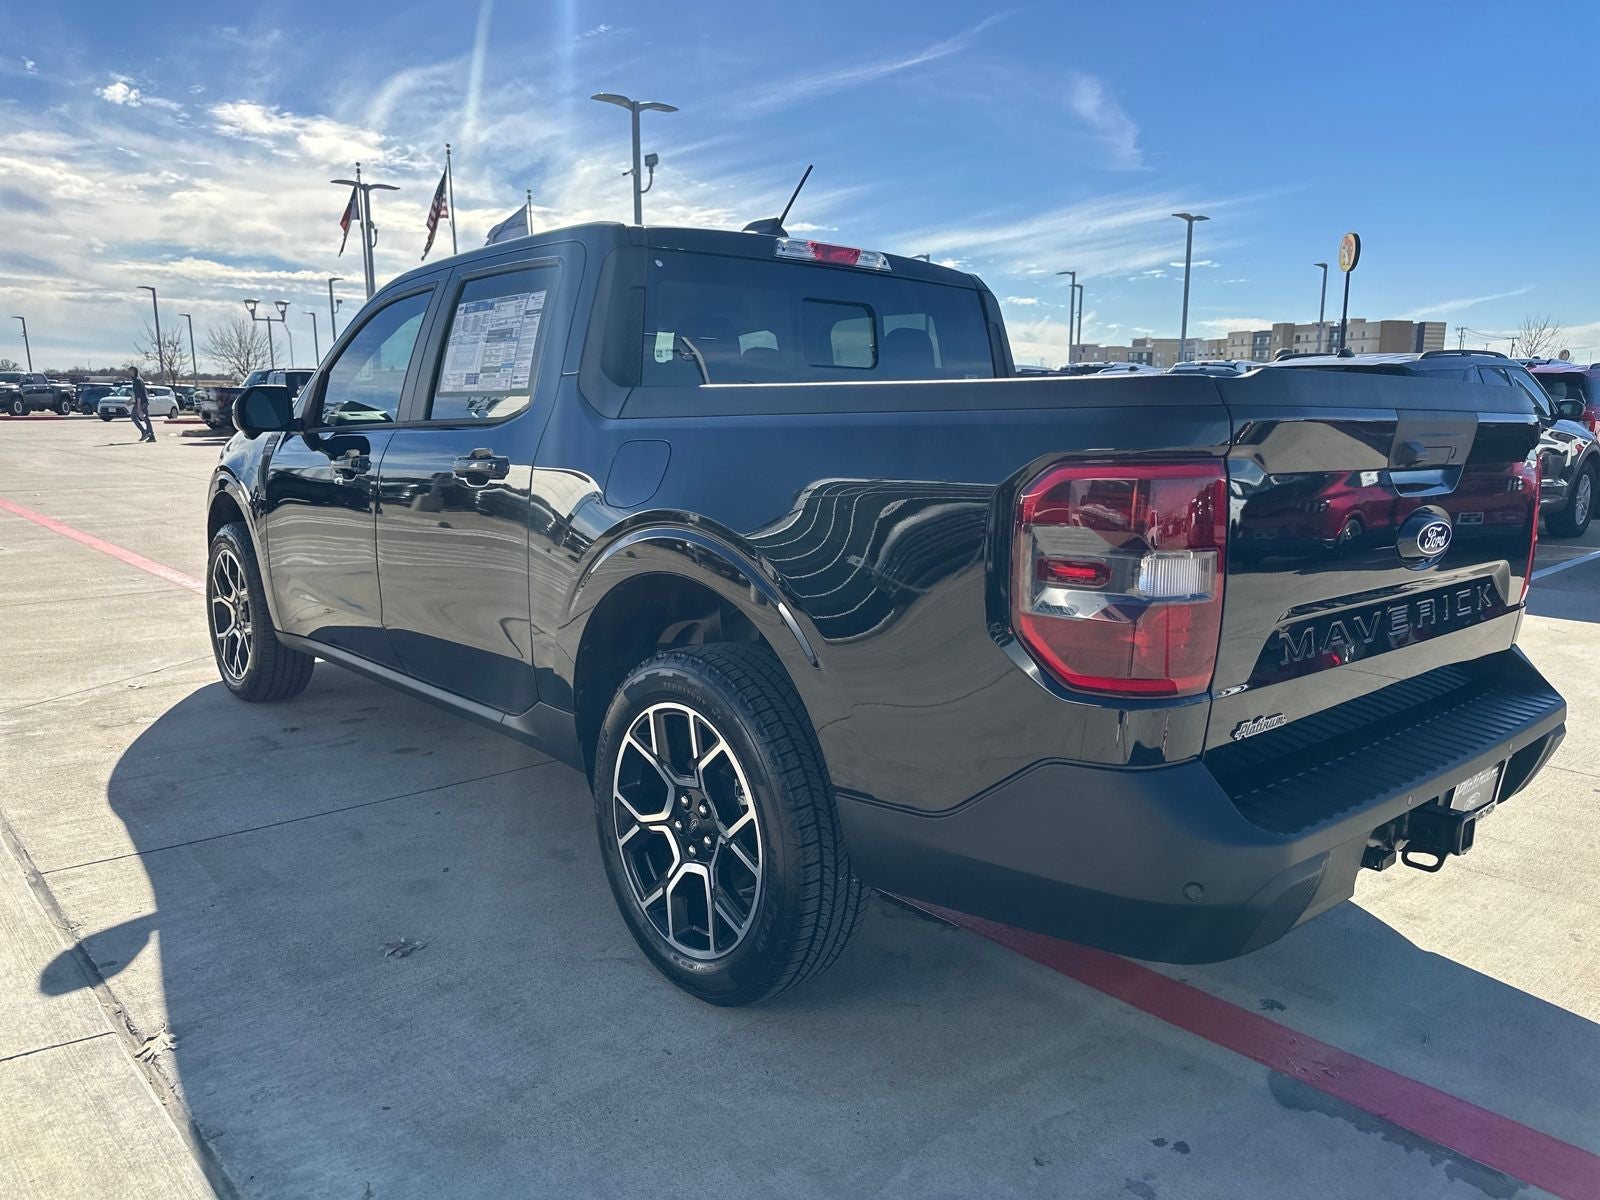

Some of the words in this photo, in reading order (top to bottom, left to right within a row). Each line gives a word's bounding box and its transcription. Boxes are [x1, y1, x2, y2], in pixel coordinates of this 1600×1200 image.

[1424, 526, 1447, 549] Ford
[1278, 583, 1493, 666] MAVERICK
[1234, 713, 1287, 741] Platinum
